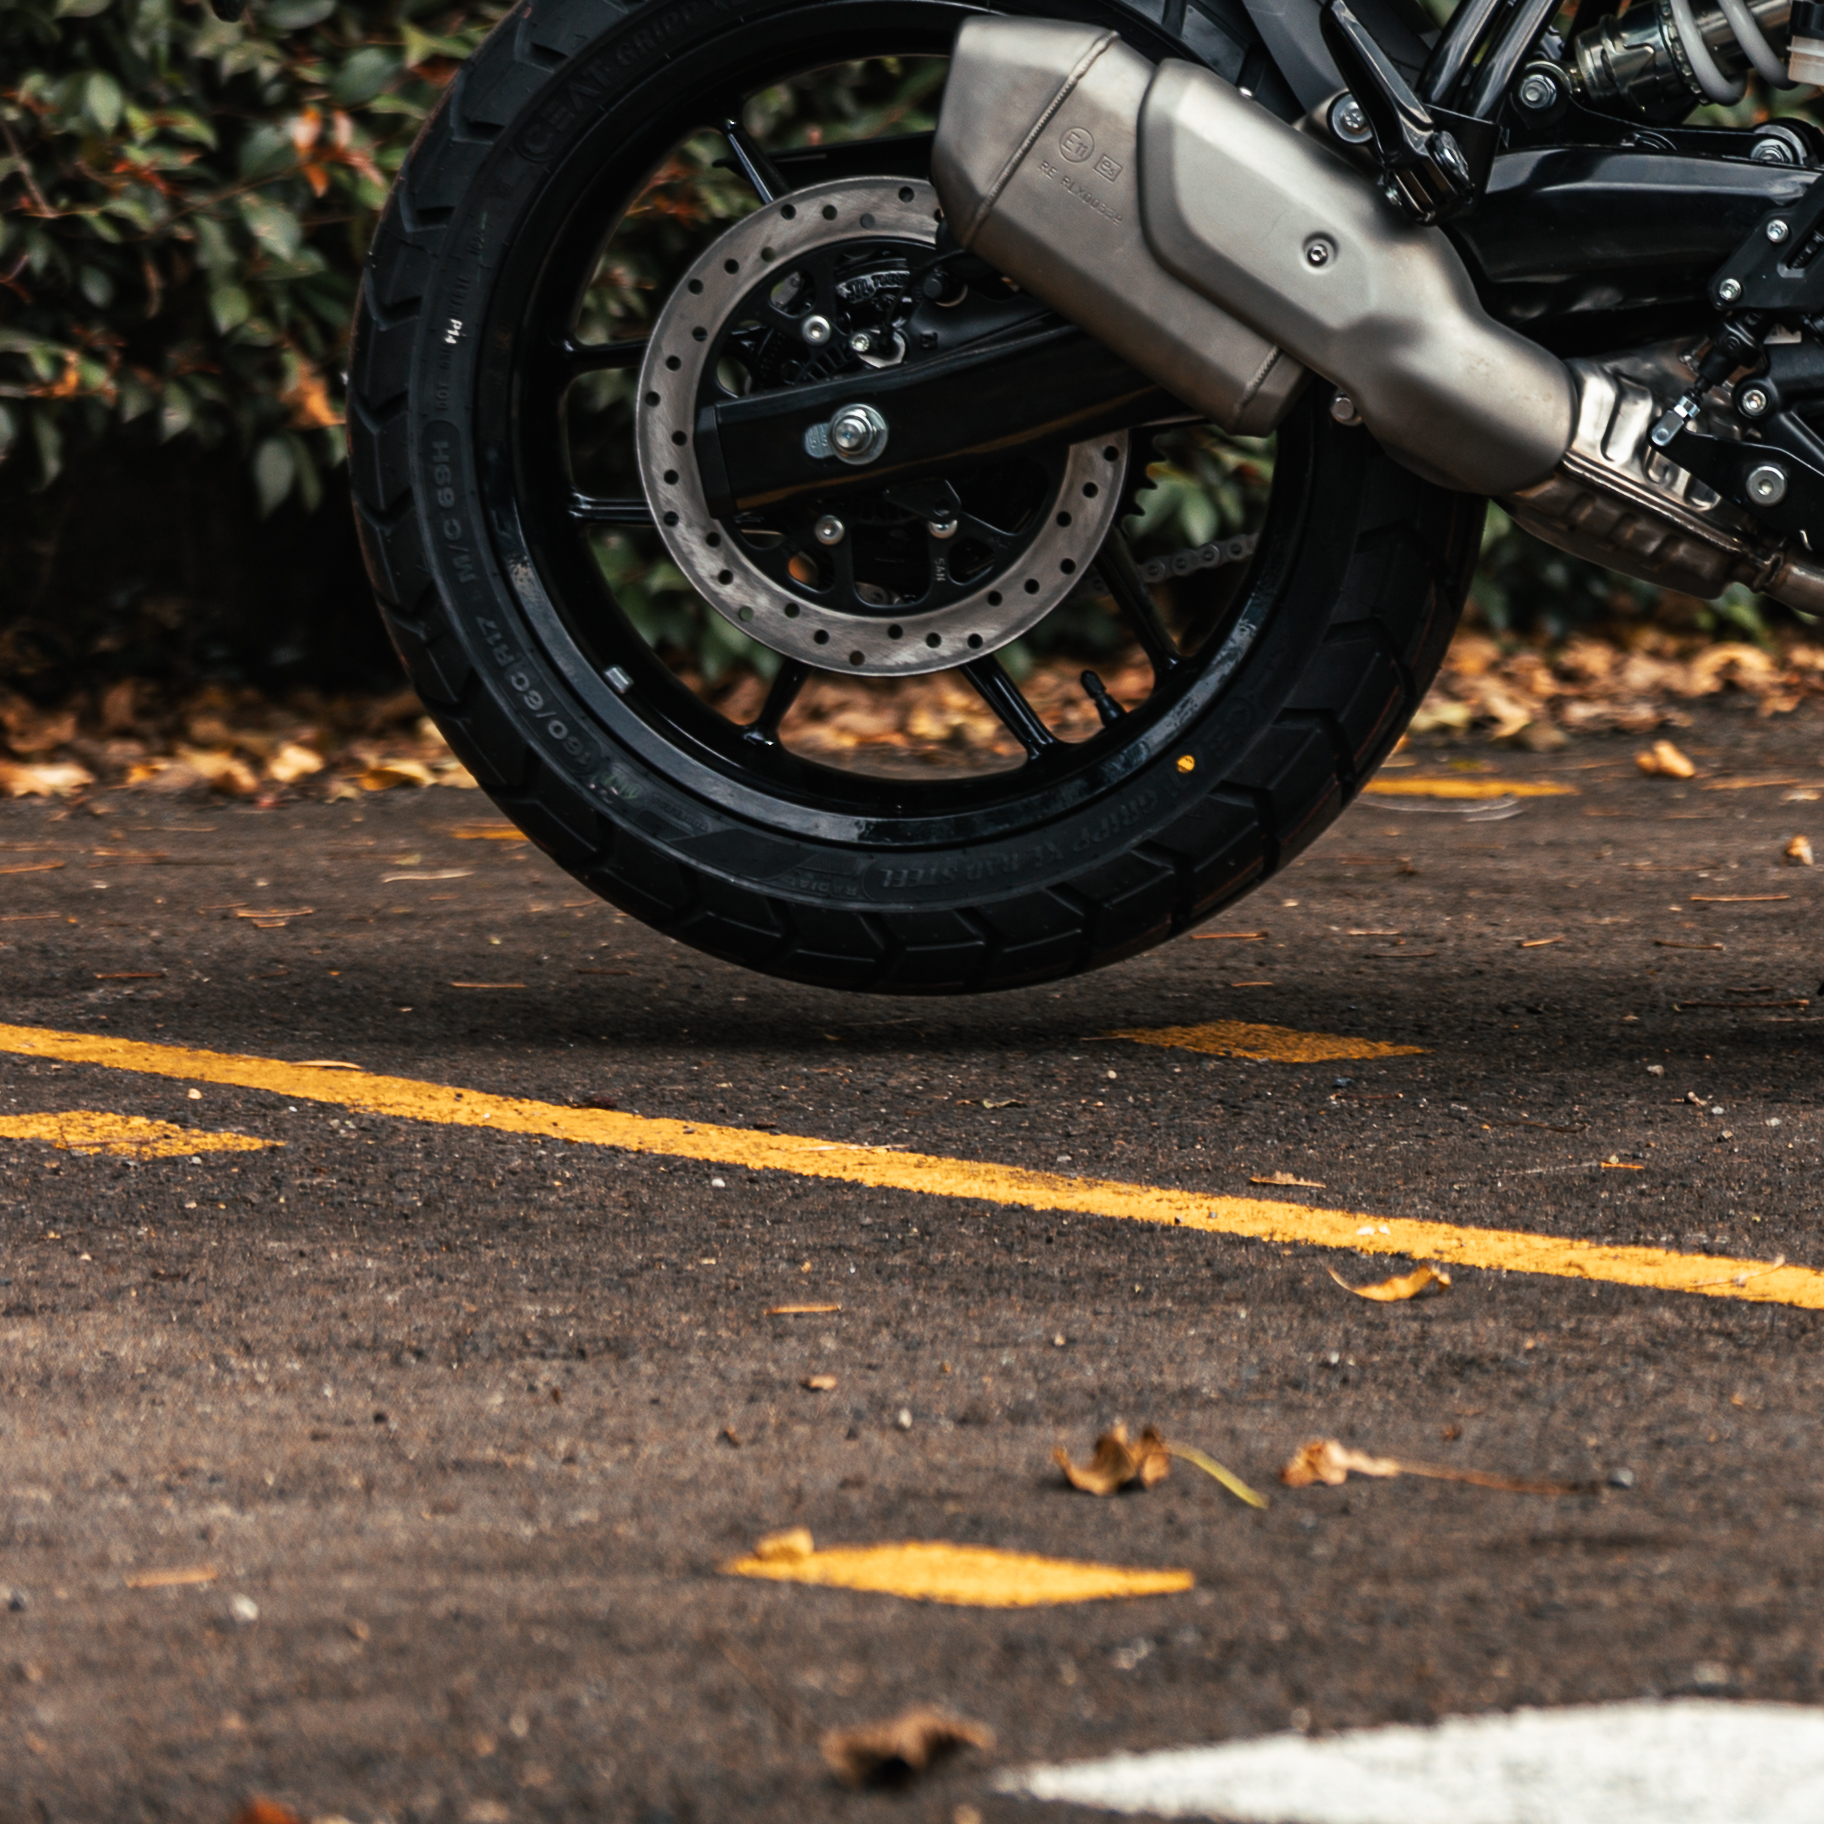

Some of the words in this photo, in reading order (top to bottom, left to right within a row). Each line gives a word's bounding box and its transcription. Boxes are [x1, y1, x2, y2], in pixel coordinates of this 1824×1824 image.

[515, 56, 617, 158] CEAT
[430, 440, 455, 508] 69H
[473, 609, 516, 668] R17
